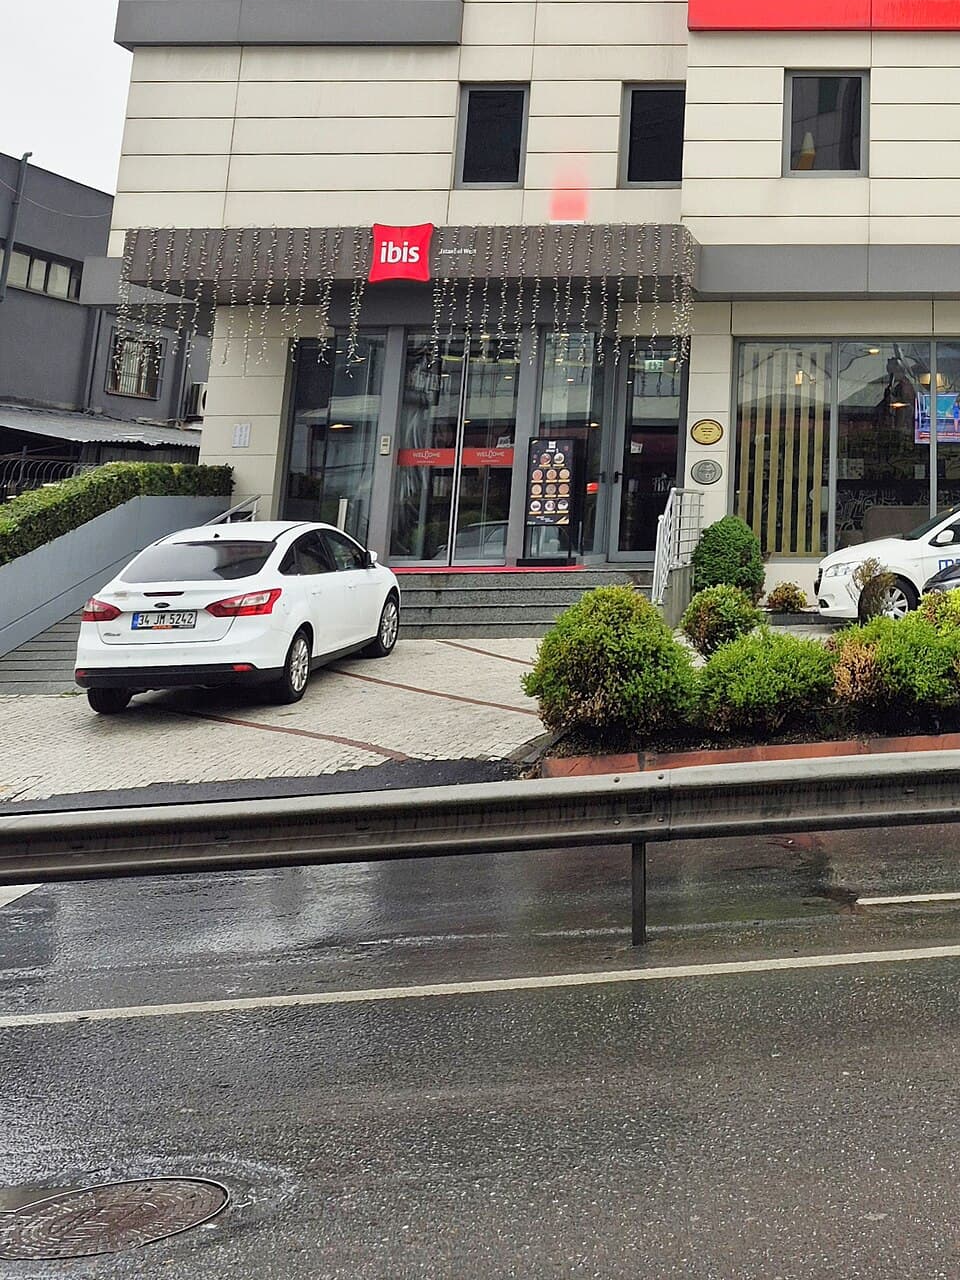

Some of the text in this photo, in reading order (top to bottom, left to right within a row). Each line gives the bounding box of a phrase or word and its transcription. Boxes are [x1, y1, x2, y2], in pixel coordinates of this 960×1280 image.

[380, 241, 420, 263] ibis
[138, 613, 193, 625] 34 JM 5242
